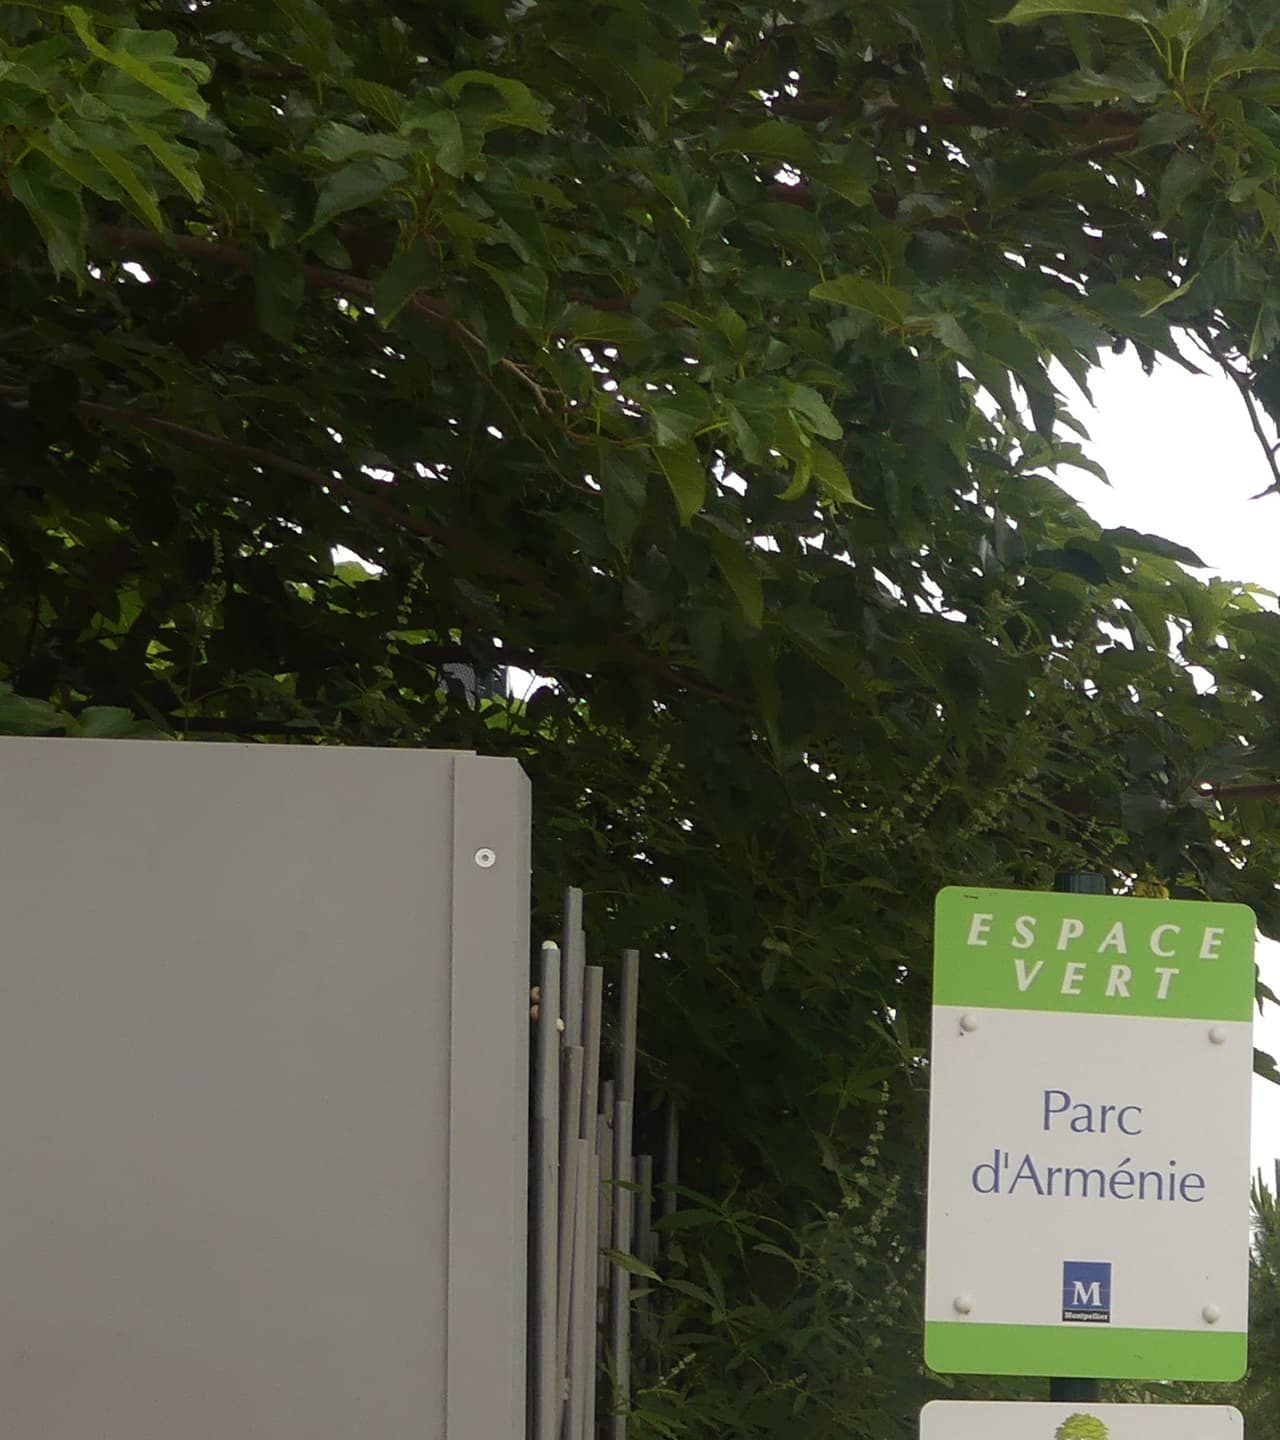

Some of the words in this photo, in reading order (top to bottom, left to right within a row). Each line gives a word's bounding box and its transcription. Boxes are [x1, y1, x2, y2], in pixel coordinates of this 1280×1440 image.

[967, 912, 1225, 960] ESPACE
[1013, 958, 1180, 1000] VERT
[1042, 1089, 1142, 1136] Parc
[971, 1148, 1206, 1204] d'Arménie
[1071, 1280, 1103, 1306] M
